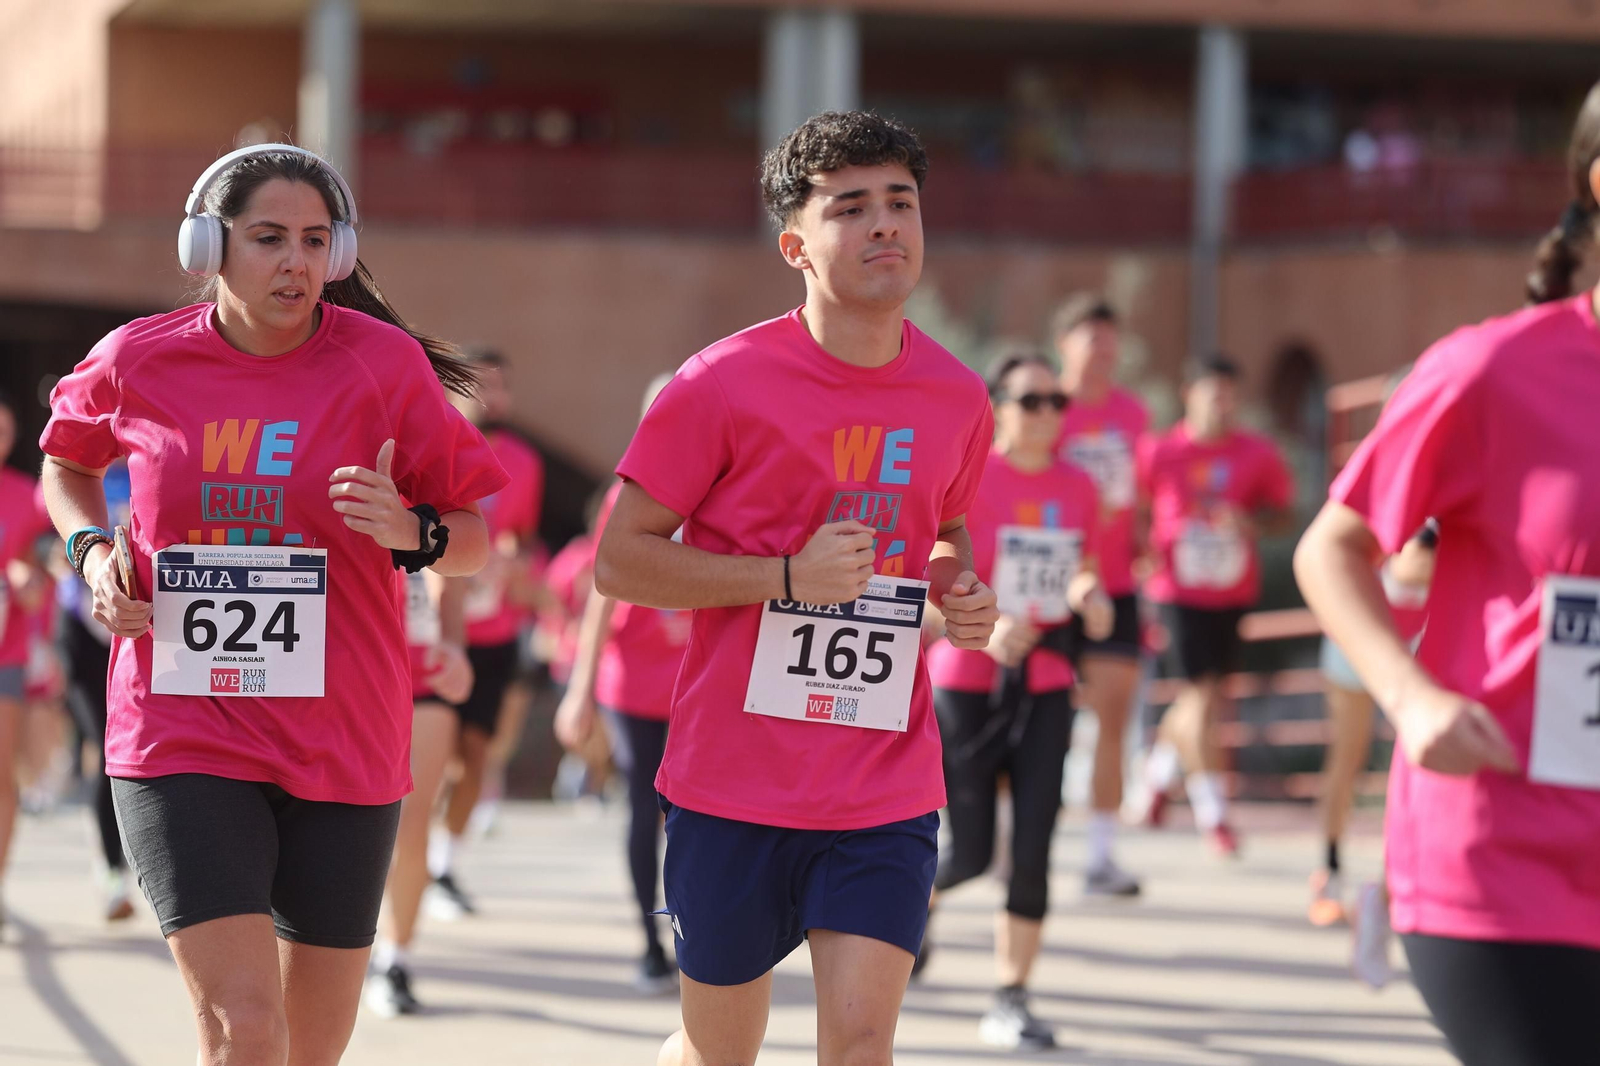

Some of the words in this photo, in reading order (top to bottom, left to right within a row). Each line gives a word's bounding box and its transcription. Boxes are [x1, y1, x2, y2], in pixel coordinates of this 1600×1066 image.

[202, 418, 299, 476] WE
[833, 425, 914, 485] WE
[206, 485, 280, 523] RUN
[832, 493, 899, 531] RUN
[255, 559, 285, 567] MÁLAGA
[161, 569, 237, 589] UMA
[290, 576, 318, 584] uma.es
[894, 608, 917, 618] uma.es
[183, 599, 300, 652] 624
[787, 624, 895, 684] 165
[211, 673, 240, 687] WE
[242, 668, 266, 678] RUN
[242, 684, 266, 693] RUN
[841, 684, 866, 692] JURADO
[808, 699, 833, 714] WE
[836, 696, 860, 707] RUN
[833, 711, 857, 722] RUN
